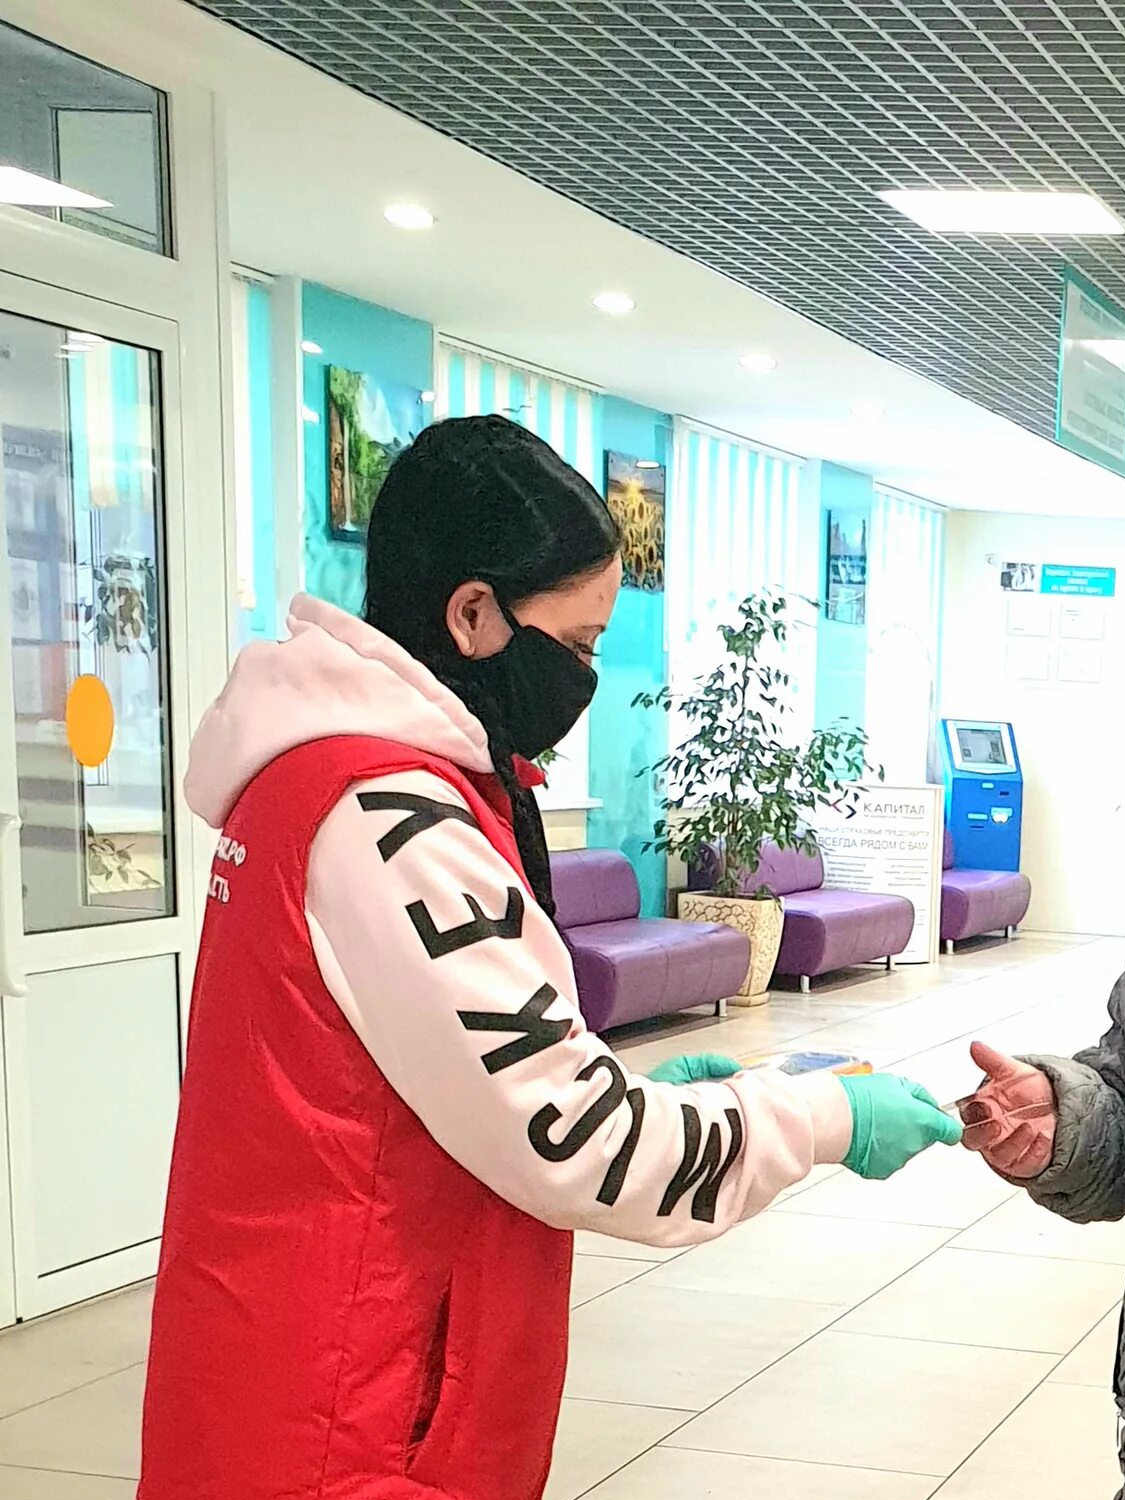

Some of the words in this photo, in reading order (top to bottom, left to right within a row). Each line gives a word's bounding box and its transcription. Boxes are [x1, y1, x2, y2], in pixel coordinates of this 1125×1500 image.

[863, 802, 925, 815] КАПИТАЛ
[818, 836, 858, 849] ВСЕГДА
[860, 839, 897, 851] РЯДОМ
[899, 841, 906, 850] С
[357, 790, 744, 1224] MICKEY
